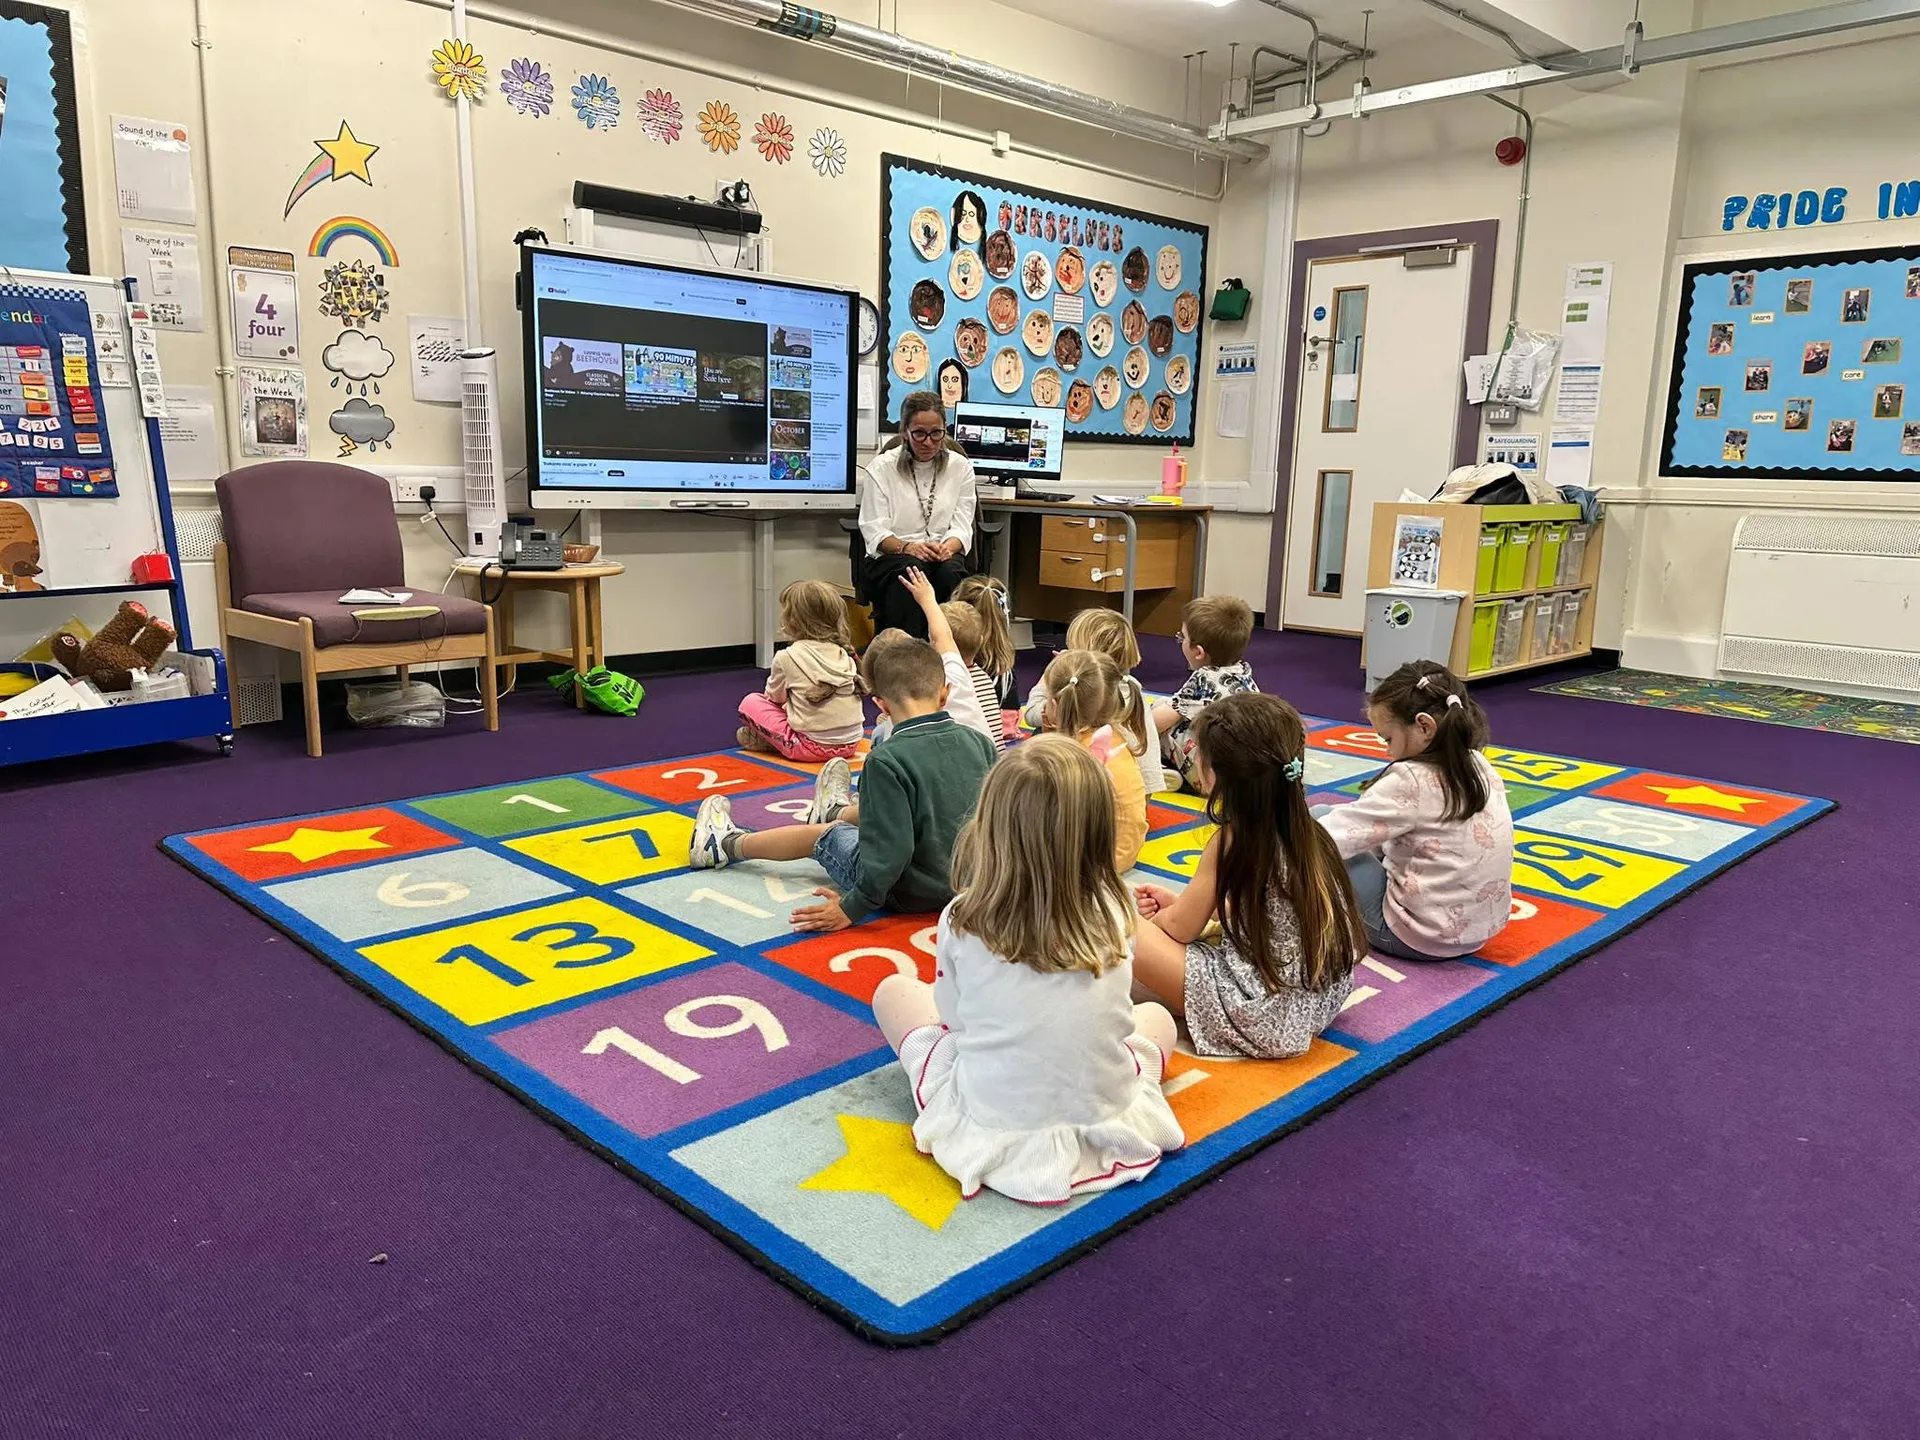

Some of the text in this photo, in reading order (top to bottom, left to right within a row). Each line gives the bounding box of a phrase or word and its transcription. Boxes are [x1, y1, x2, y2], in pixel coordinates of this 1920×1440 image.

[119, 124, 168, 138] Sound of the
[1722, 180, 1920, 231] PRIDE IN
[998, 200, 1123, 254] OURSELVES
[136, 235, 185, 248] Rhyme of the
[151, 248, 172, 256] Week
[255, 293, 277, 320] 4
[248, 320, 285, 338] four
[576, 355, 619, 365] BEETHOVEN
[654, 352, 665, 361] 90
[258, 374, 287, 384] Book of
[253, 386, 293, 397] the Week
[775, 424, 805, 435] OCTOBER
[37, 438, 44, 446] 9
[53, 440, 60, 448] 5
[1491, 754, 1580, 781] 25
[660, 767, 748, 790] 2
[501, 793, 571, 814] 1
[1565, 807, 1700, 847] 30
[582, 828, 660, 859] 7
[1514, 841, 1626, 891] 29
[376, 872, 470, 908] 6
[435, 922, 636, 987] 13
[581, 995, 791, 1085] 19
